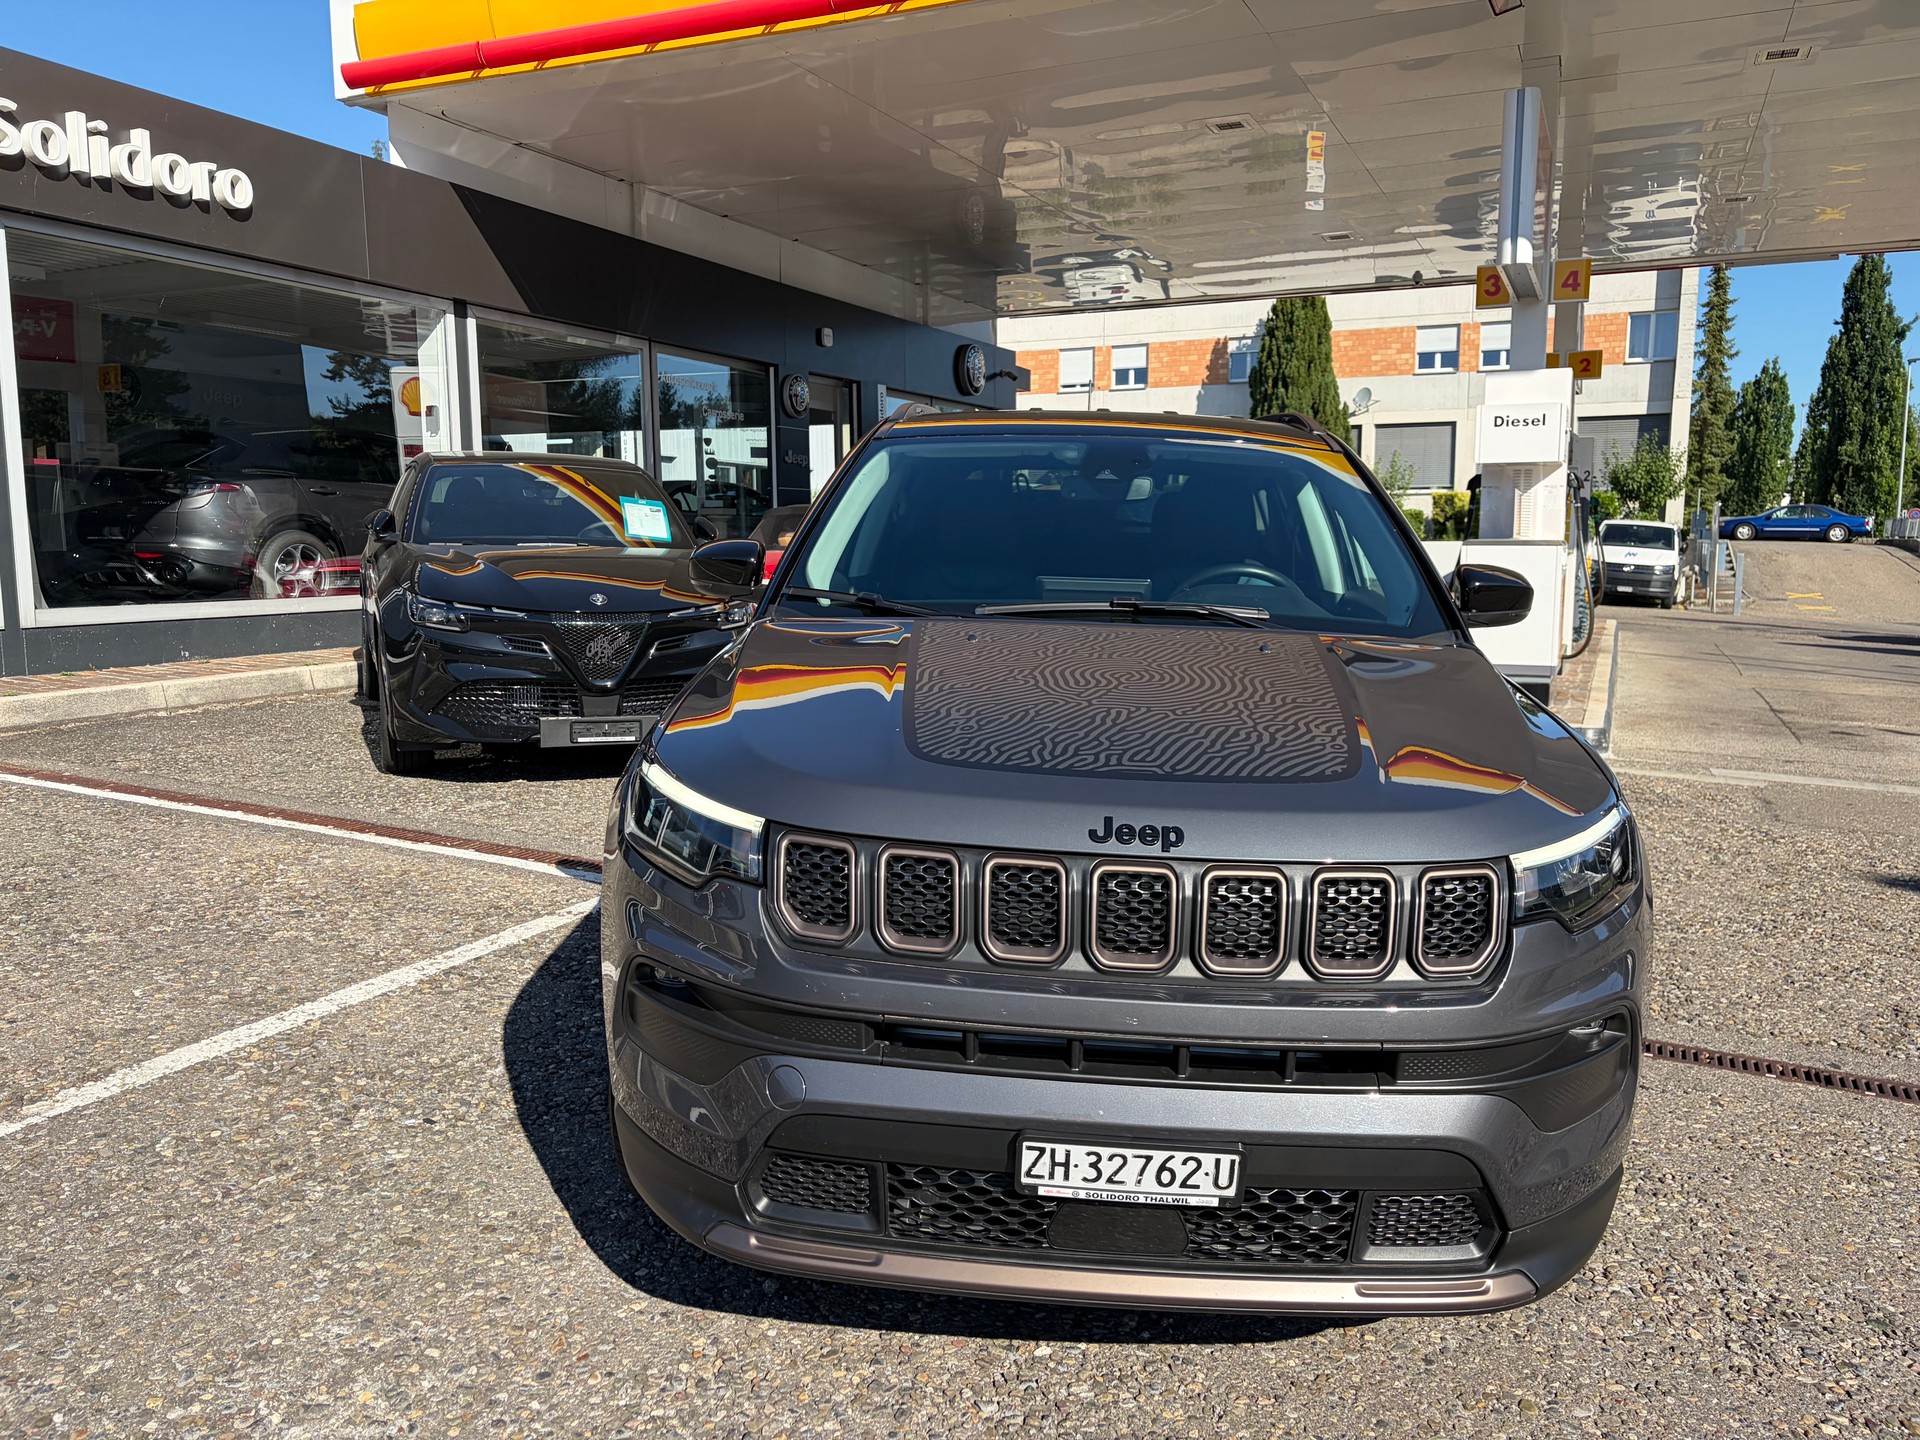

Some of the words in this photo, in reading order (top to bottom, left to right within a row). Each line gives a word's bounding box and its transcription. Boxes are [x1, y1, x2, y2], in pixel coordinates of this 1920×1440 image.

[0, 97, 253, 209] Solidoro
[1483, 274, 1502, 297] 3
[1561, 270, 1581, 292] 4
[1579, 358, 1592, 373] 2
[202, 386, 242, 408] Jeep
[702, 405, 745, 421] Carrosserie
[1494, 413, 1546, 427] Diesel
[783, 450, 809, 467] Jeep
[1583, 470, 1591, 481] 2
[1088, 816, 1185, 853] Jeep
[1085, 1191, 1140, 1201] SOLIDORO
[1143, 1195, 1191, 1204] THALWIL
[1195, 1198, 1213, 1206] Jeep
